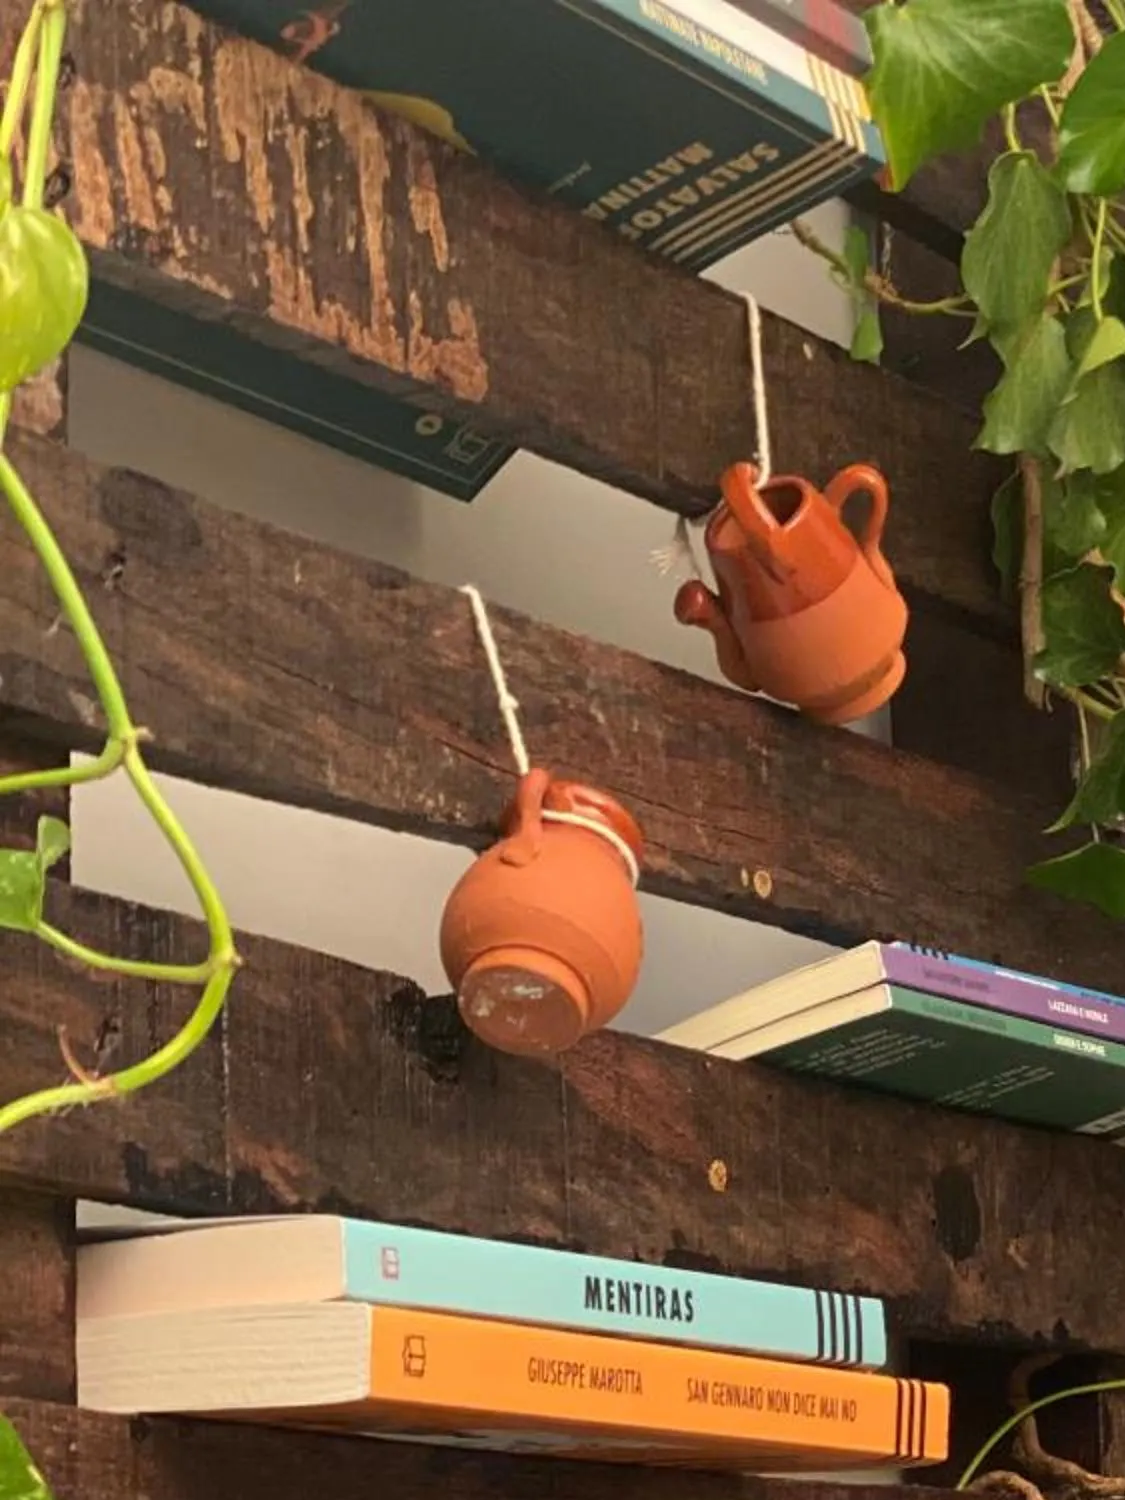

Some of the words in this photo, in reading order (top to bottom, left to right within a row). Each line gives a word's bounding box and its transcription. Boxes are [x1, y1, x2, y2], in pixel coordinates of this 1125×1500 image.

[582, 141, 713, 220] MATTINA
[584, 1275, 694, 1323] MENTIRAS
[527, 1356, 586, 1389] GIUSEPPE
[589, 1366, 643, 1395] MAROTTA
[687, 1377, 709, 1404] SAN
[711, 1382, 764, 1412] GENNARO
[767, 1389, 790, 1414] NON
[793, 1392, 816, 1418] DICE
[819, 1395, 839, 1420] MAI
[841, 1399, 857, 1423] NO
